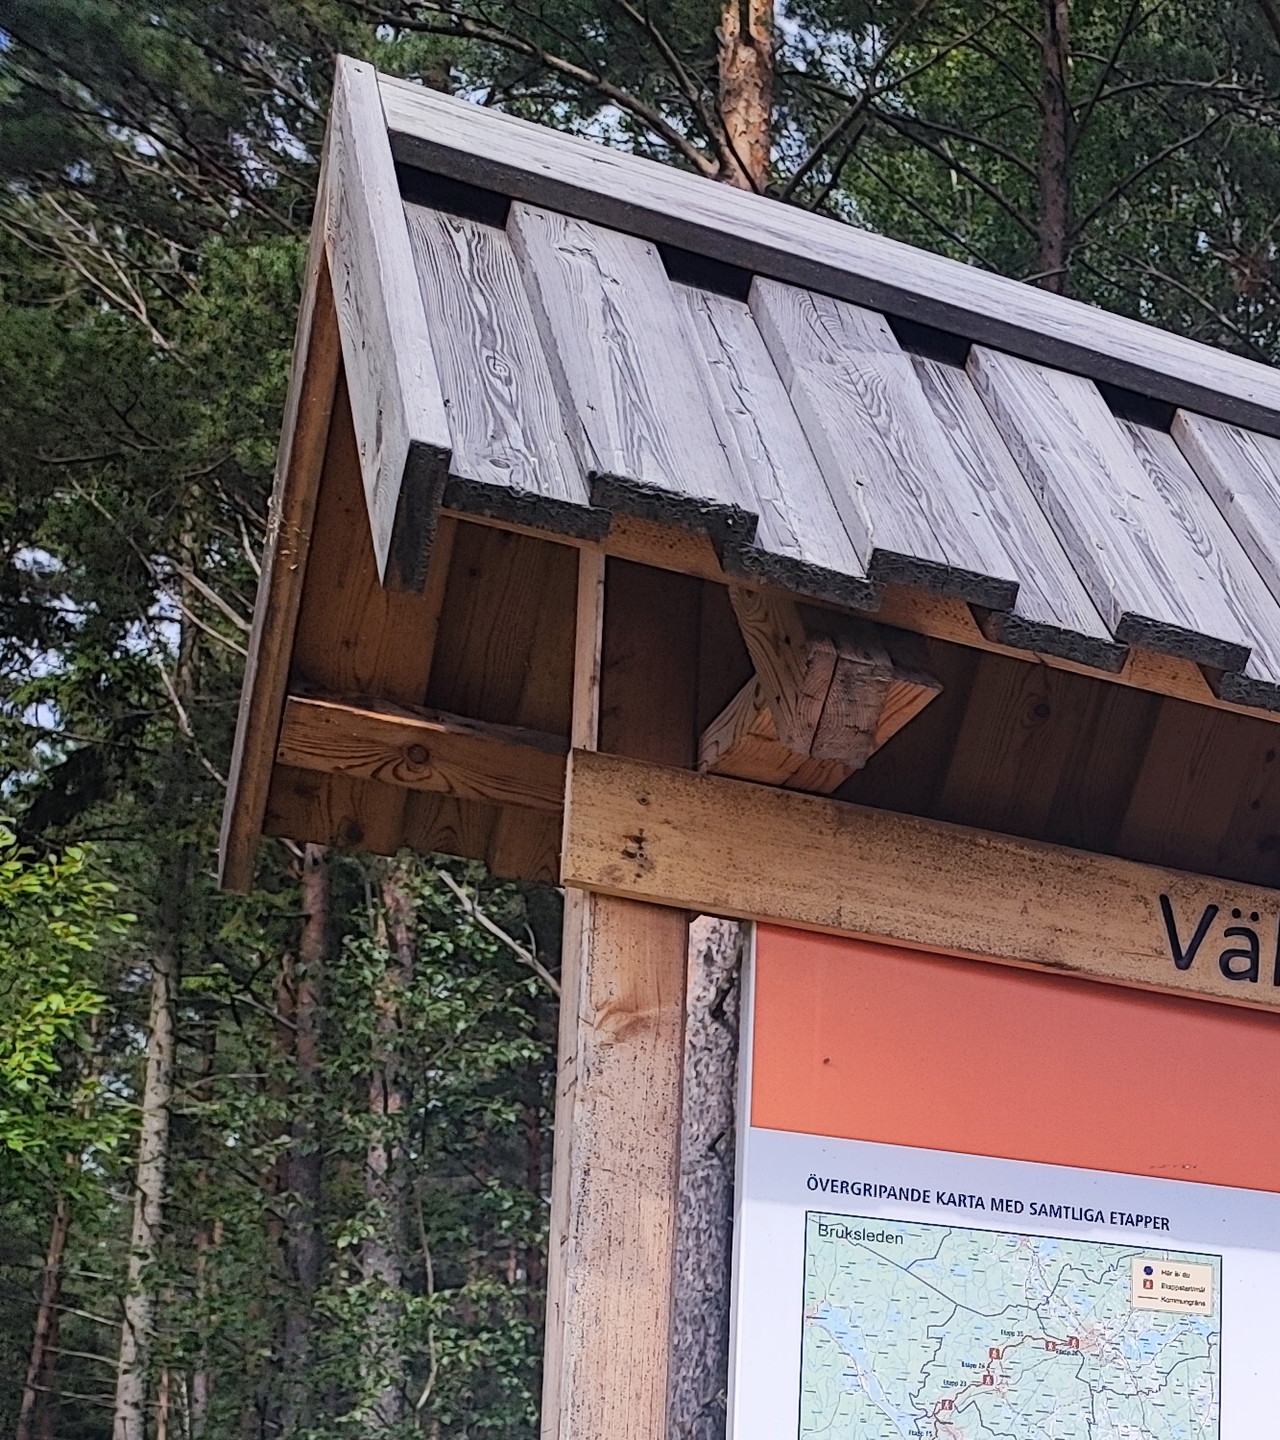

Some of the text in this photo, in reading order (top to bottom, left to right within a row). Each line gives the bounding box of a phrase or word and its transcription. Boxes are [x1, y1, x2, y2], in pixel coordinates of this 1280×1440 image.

[806, 1173, 1170, 1231] ÖVERGRIPANDE KARTA MED SAMTLIGA ETAPPER
[818, 1224, 904, 1245] Bruksleden
